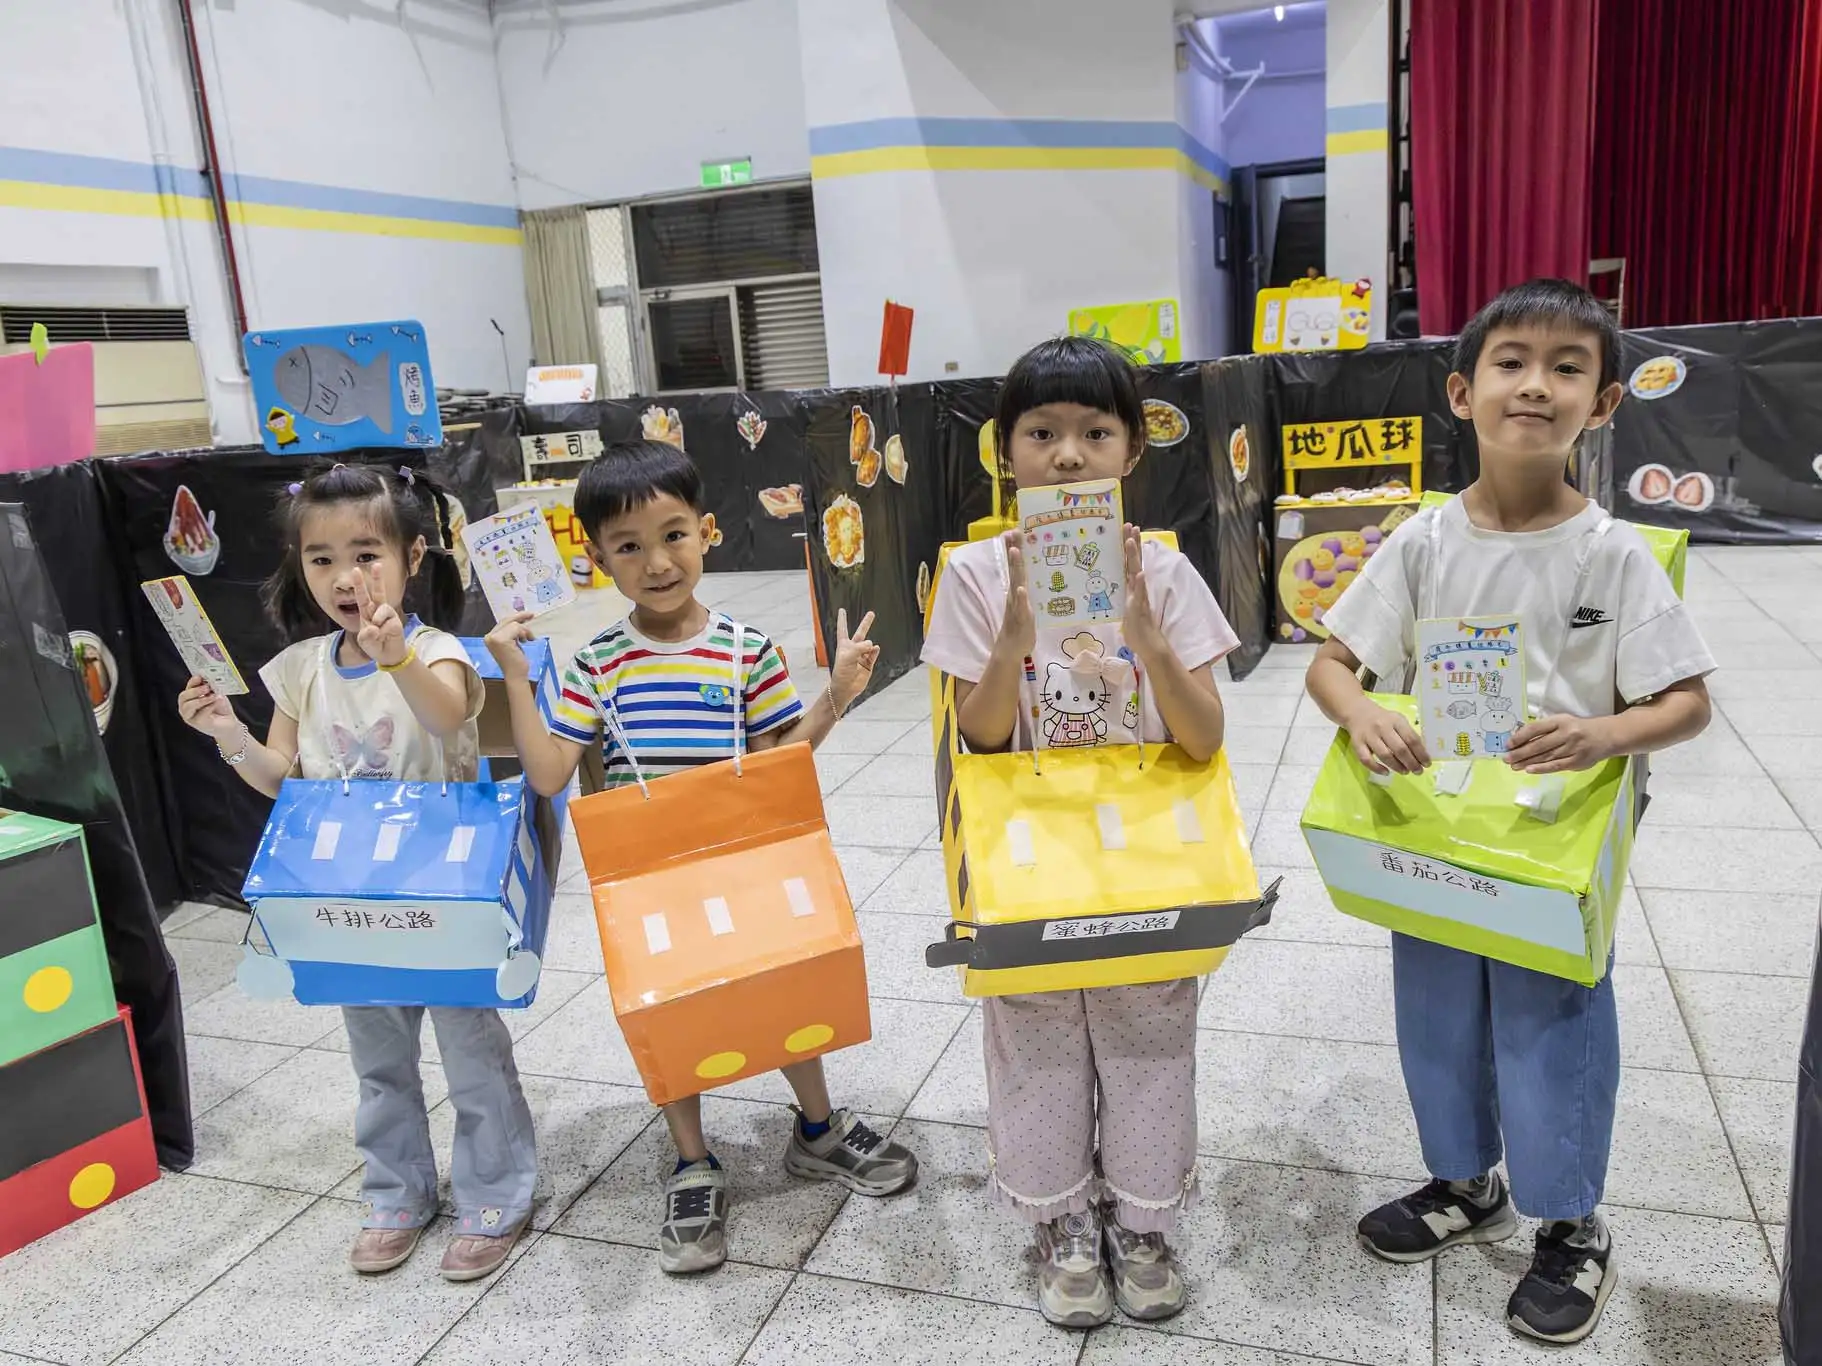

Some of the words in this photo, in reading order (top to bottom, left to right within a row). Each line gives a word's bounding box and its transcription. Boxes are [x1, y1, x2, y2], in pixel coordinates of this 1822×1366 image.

[531, 434, 583, 460] 壽司
[1288, 419, 1415, 460] 地瓜球
[1575, 606, 1606, 621] NIKE
[1380, 852, 1500, 896] 番茄公路
[315, 906, 438, 929] 牛排公路
[1051, 916, 1169, 937] 蜜蜂公路
